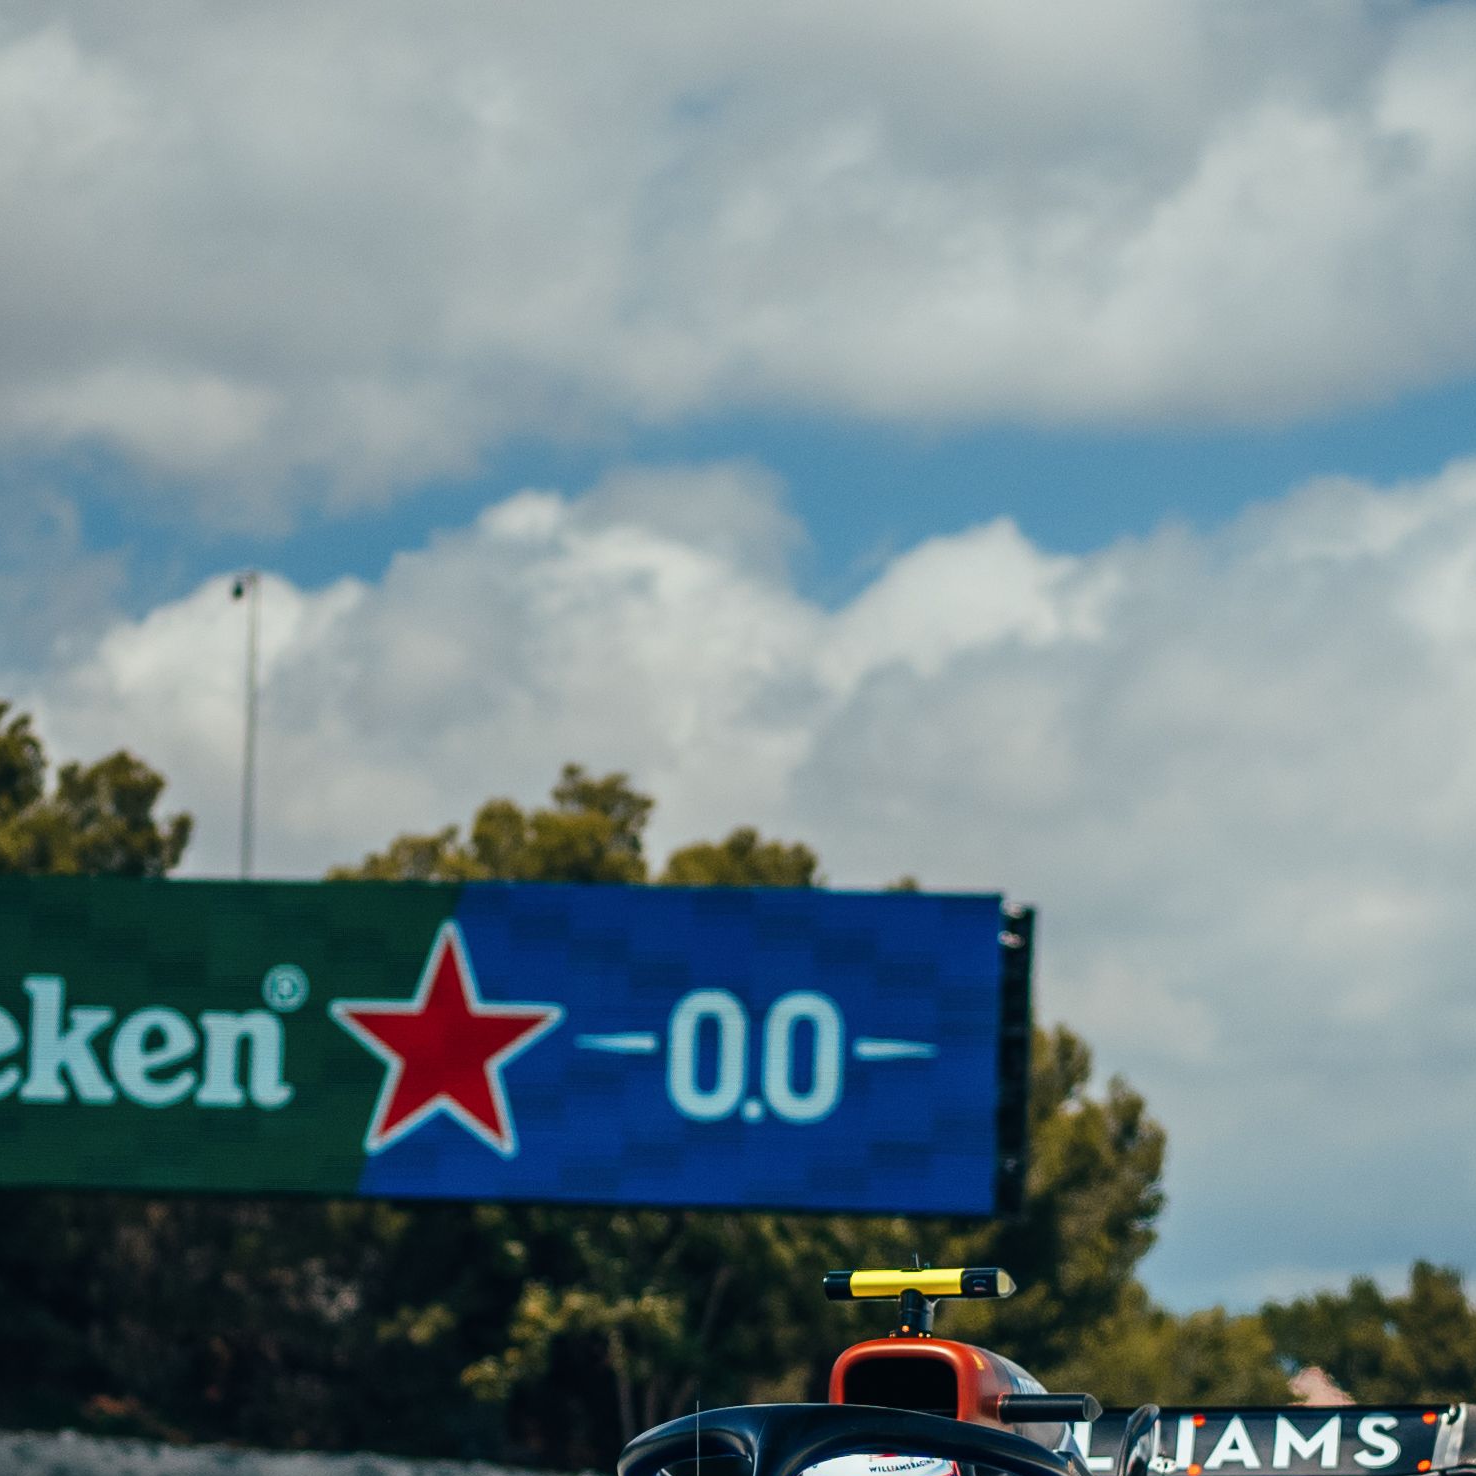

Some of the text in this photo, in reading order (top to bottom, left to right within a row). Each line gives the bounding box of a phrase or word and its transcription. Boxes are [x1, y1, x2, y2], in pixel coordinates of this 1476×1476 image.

[668, 991, 844, 1121] 0.0
[869, 1463, 911, 1473] WILLIAMS
[1073, 1413, 1401, 1469] LIAMS
